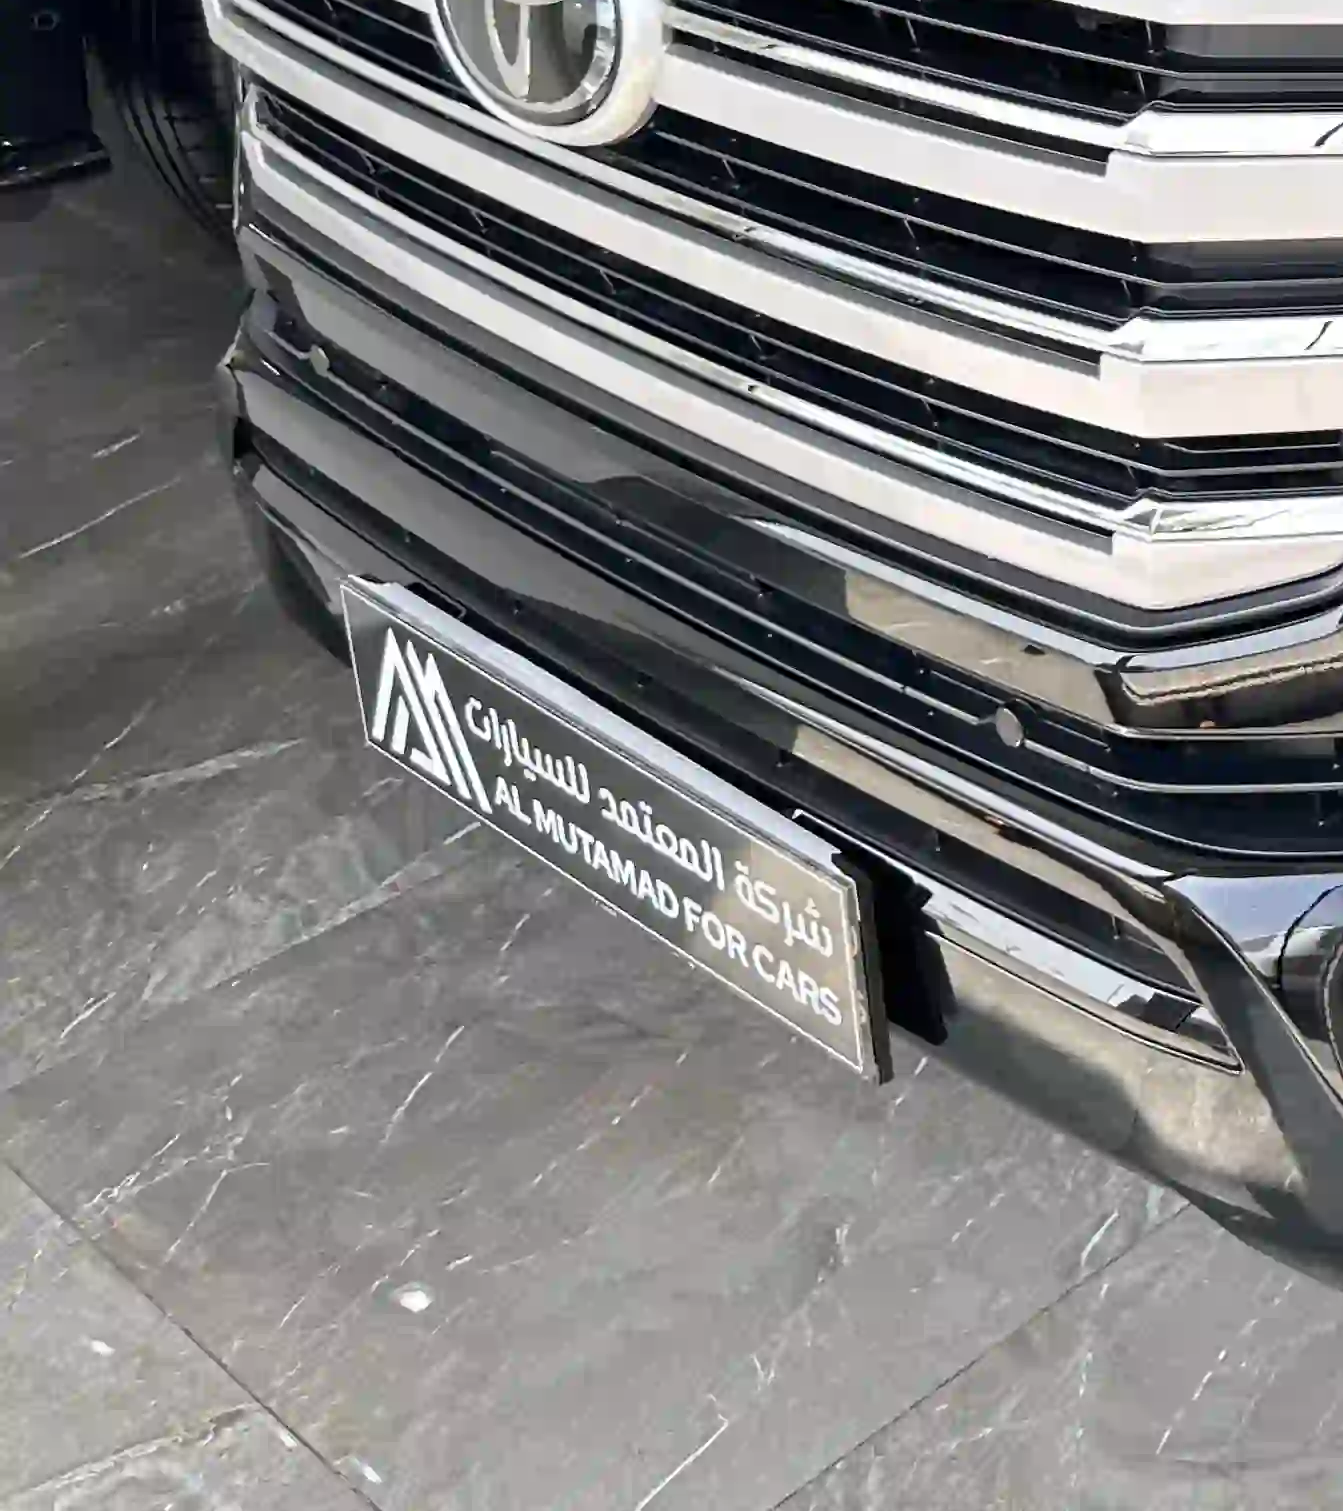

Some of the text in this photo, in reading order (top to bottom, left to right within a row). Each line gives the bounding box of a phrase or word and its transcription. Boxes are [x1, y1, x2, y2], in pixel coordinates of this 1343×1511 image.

[464, 696, 833, 958] شركة المعتمد للسيارات
[494, 776, 843, 1026] AL MUTAMAD FOR CARS
